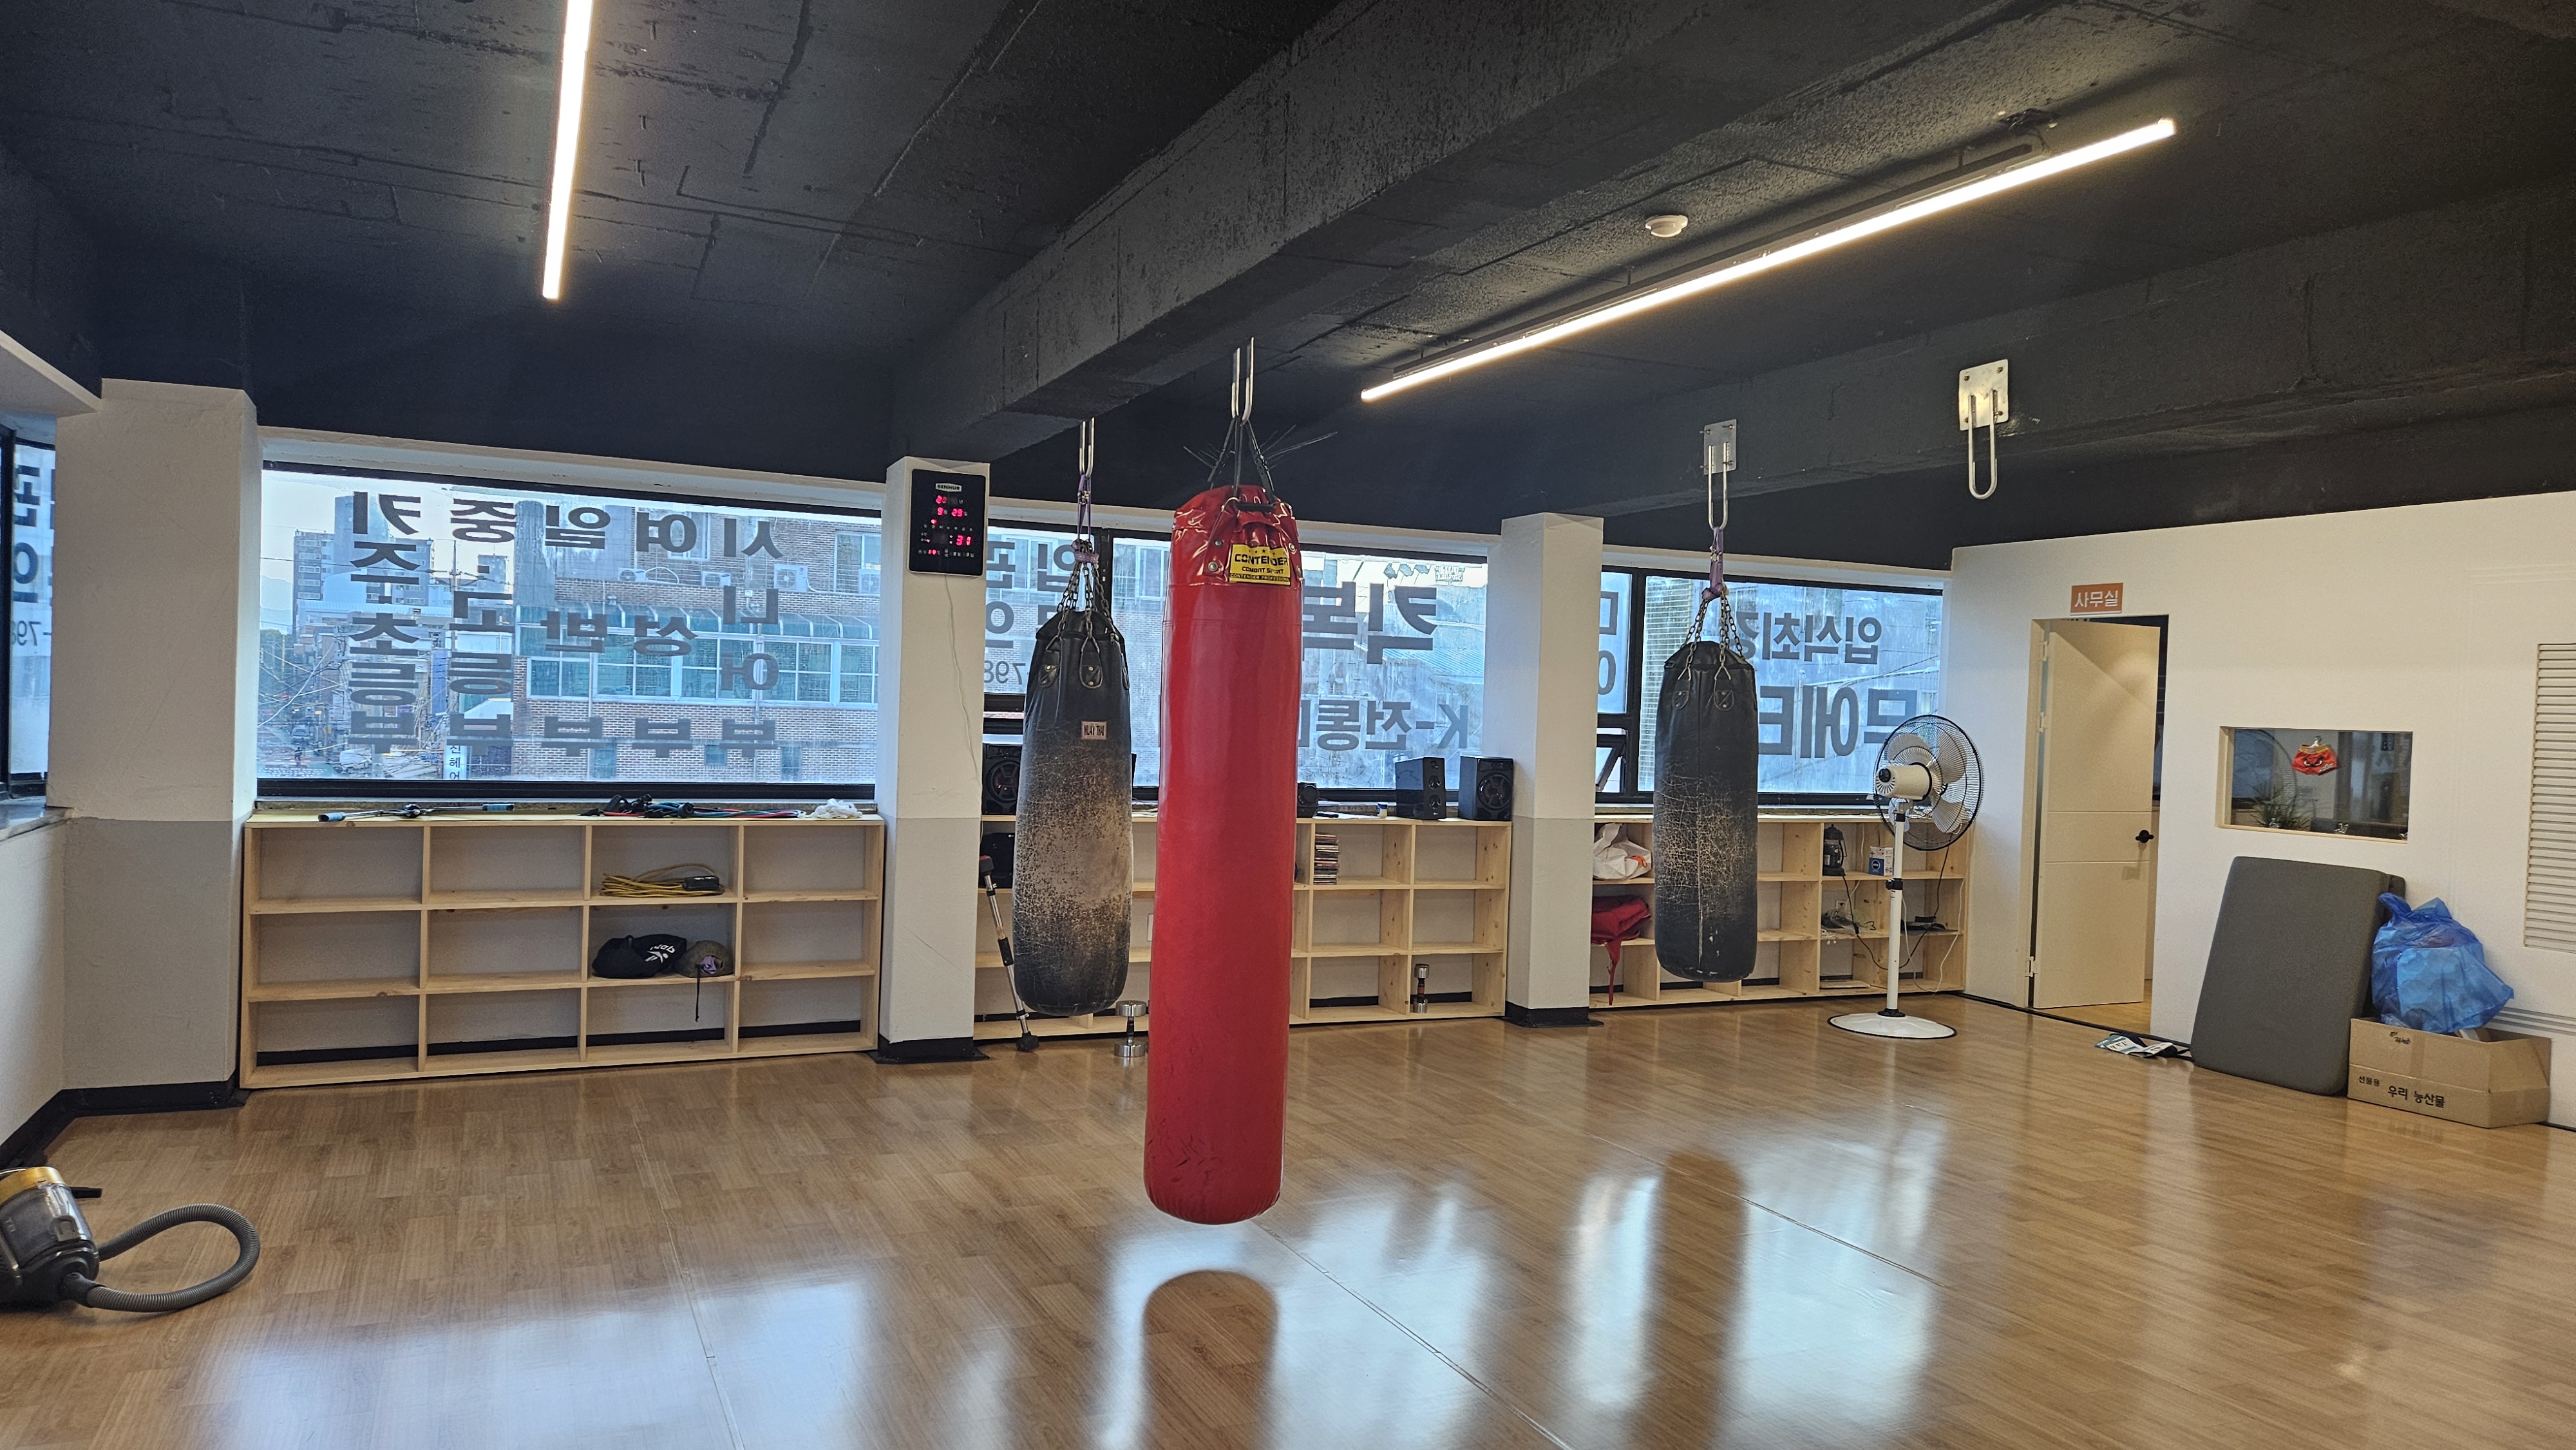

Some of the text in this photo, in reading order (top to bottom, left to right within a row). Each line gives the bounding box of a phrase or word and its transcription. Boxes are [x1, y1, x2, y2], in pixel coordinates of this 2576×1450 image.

[1235, 553, 1288, 566] CONTENDER
[2074, 590, 2118, 608] 사무실
[2358, 1076, 2380, 1087] 선물용
[2387, 1086, 2445, 1108] 우리 농산물
